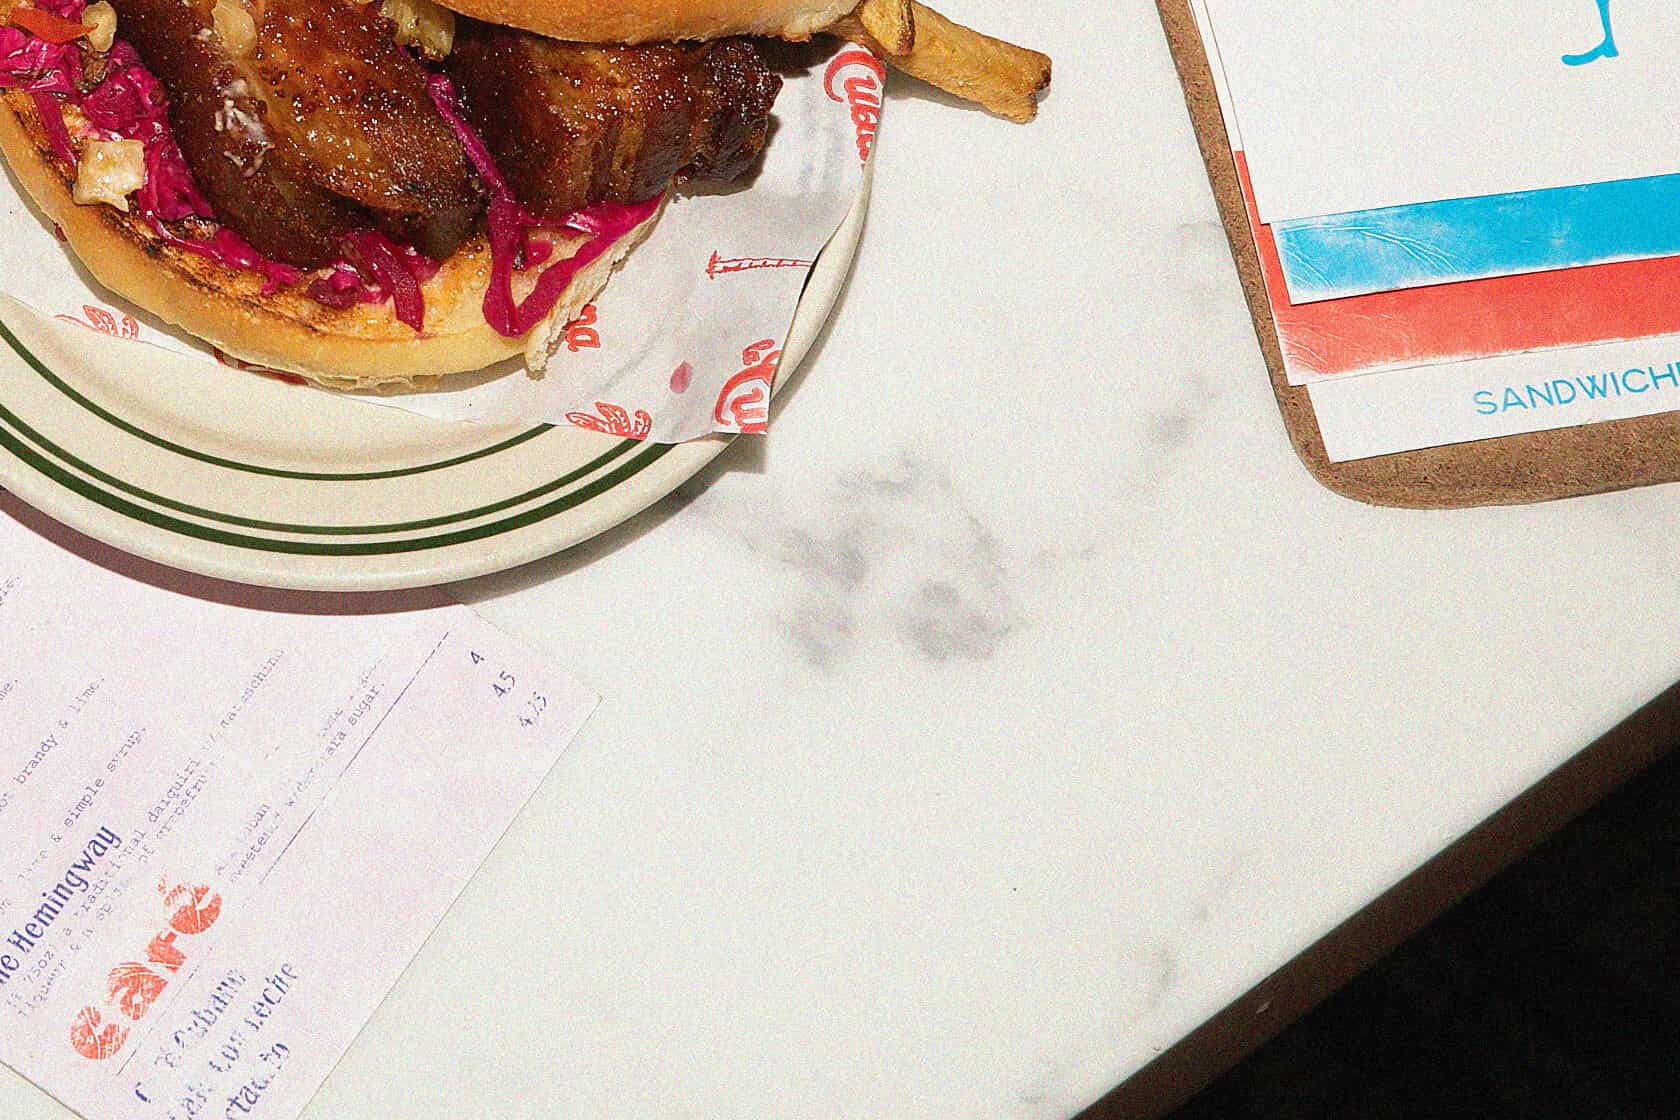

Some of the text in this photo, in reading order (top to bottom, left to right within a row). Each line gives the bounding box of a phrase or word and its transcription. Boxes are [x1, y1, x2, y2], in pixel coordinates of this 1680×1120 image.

[742, 338, 776, 366] la
[469, 650, 485, 665] 4
[346, 682, 385, 726] sugar.
[491, 669, 515, 697] 4.5
[12, 733, 58, 784] brandy
[49, 833, 63, 843] &
[63, 777, 105, 827] simple
[146, 759, 201, 823] daiquiri
[5, 825, 122, 953] Hemingway
